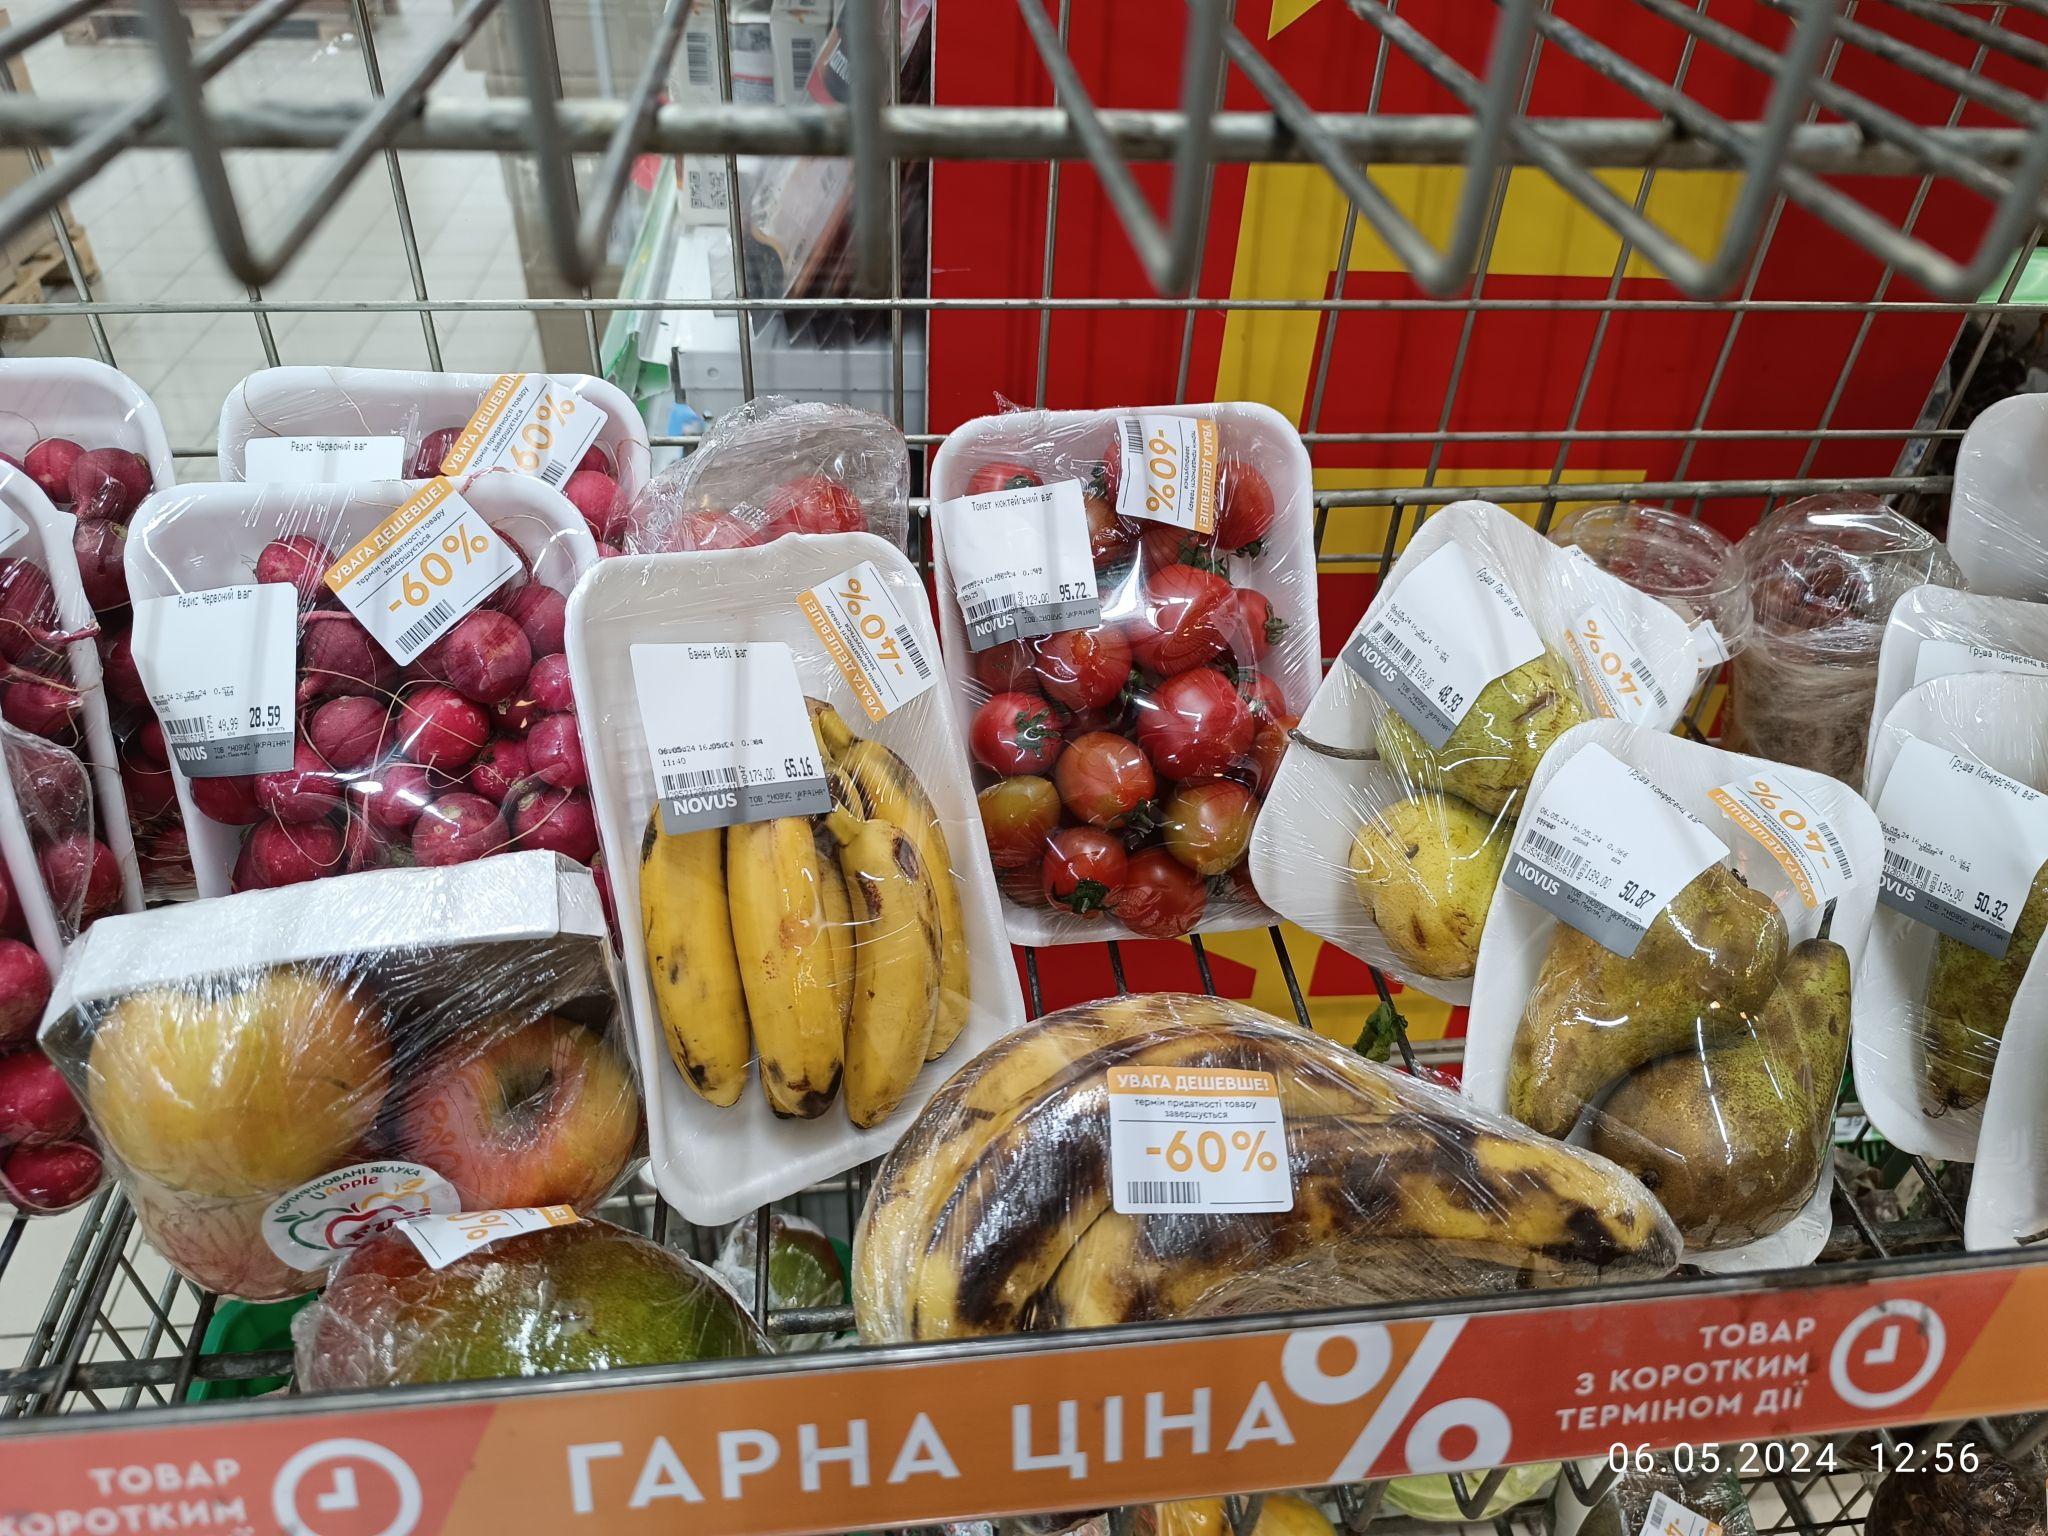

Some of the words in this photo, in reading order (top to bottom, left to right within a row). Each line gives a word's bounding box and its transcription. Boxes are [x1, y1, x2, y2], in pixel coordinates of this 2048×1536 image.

[472, 446, 488, 469] термін
[487, 408, 515, 448] придатності
[512, 386, 530, 408] товару
[493, 409, 524, 453] завершується
[511, 393, 576, 471] 60%
[1202, 424, 1213, 456] УВАГА
[446, 434, 477, 471] УВАГА
[1146, 429, 1177, 512] -60%
[972, 501, 991, 512] Томат
[332, 546, 375, 583] УВАГА
[374, 483, 445, 549] ДЕШЕВШЕ!
[356, 565, 381, 587] термін
[380, 529, 422, 566] придатності
[420, 508, 445, 531] товару
[383, 533, 432, 576] завершується
[388, 523, 489, 613] -60%
[1059, 582, 1087, 601] 95.72
[804, 598, 857, 672] ДЕШЕВШЕ!
[825, 605, 843, 631] товару
[838, 578, 904, 675] -40%
[975, 613, 1015, 637] NOVUS
[1357, 642, 1398, 682] NOVUS
[1583, 619, 1643, 706] -40%
[853, 673, 881, 715] УВАГА
[1438, 684, 1464, 713] 48.93
[250, 705, 281, 728] 28.59
[176, 745, 208, 762] NOVUS
[784, 756, 815, 778] 65.16
[673, 792, 738, 816] NOVUS
[1715, 793, 1787, 854] ДЕШЕВШЕ!
[1738, 798, 1761, 821] товару
[1747, 781, 1830, 869] -40%
[1514, 860, 1560, 896] NOVUS
[1618, 879, 1657, 909] 50.87
[1786, 857, 1814, 901] УВАГА
[1880, 874, 1917, 902] OVUS
[1937, 881, 1965, 901] 139.00
[1974, 891, 2009, 921] 50.32
[1117, 1074, 1172, 1089] УВАГА
[1175, 1074, 1270, 1092] ДЕШЕВШЕ!
[1135, 1099, 1166, 1107] термін
[1167, 1099, 1223, 1109] придатності
[1224, 1101, 1257, 1109] товару
[1165, 1111, 1229, 1120] завершується
[1146, 1130, 1278, 1173] -60%
[274, 1167, 366, 1215] СЕРТИФІКОВАНІ
[369, 1165, 422, 1178] ЯБЛУКА
[1699, 1317, 1817, 1351] ТОВАР
[1609, 1351, 1809, 1394] КОРОТКИМ
[1554, 1393, 1744, 1432] ТЕРМІНОМ
[1753, 1380, 1810, 1417] ДІЇ
[565, 1411, 960, 1515] ГАРНА
[1011, 1379, 1294, 1479] ЦІНА
[87, 1456, 241, 1497] ТОВАР
